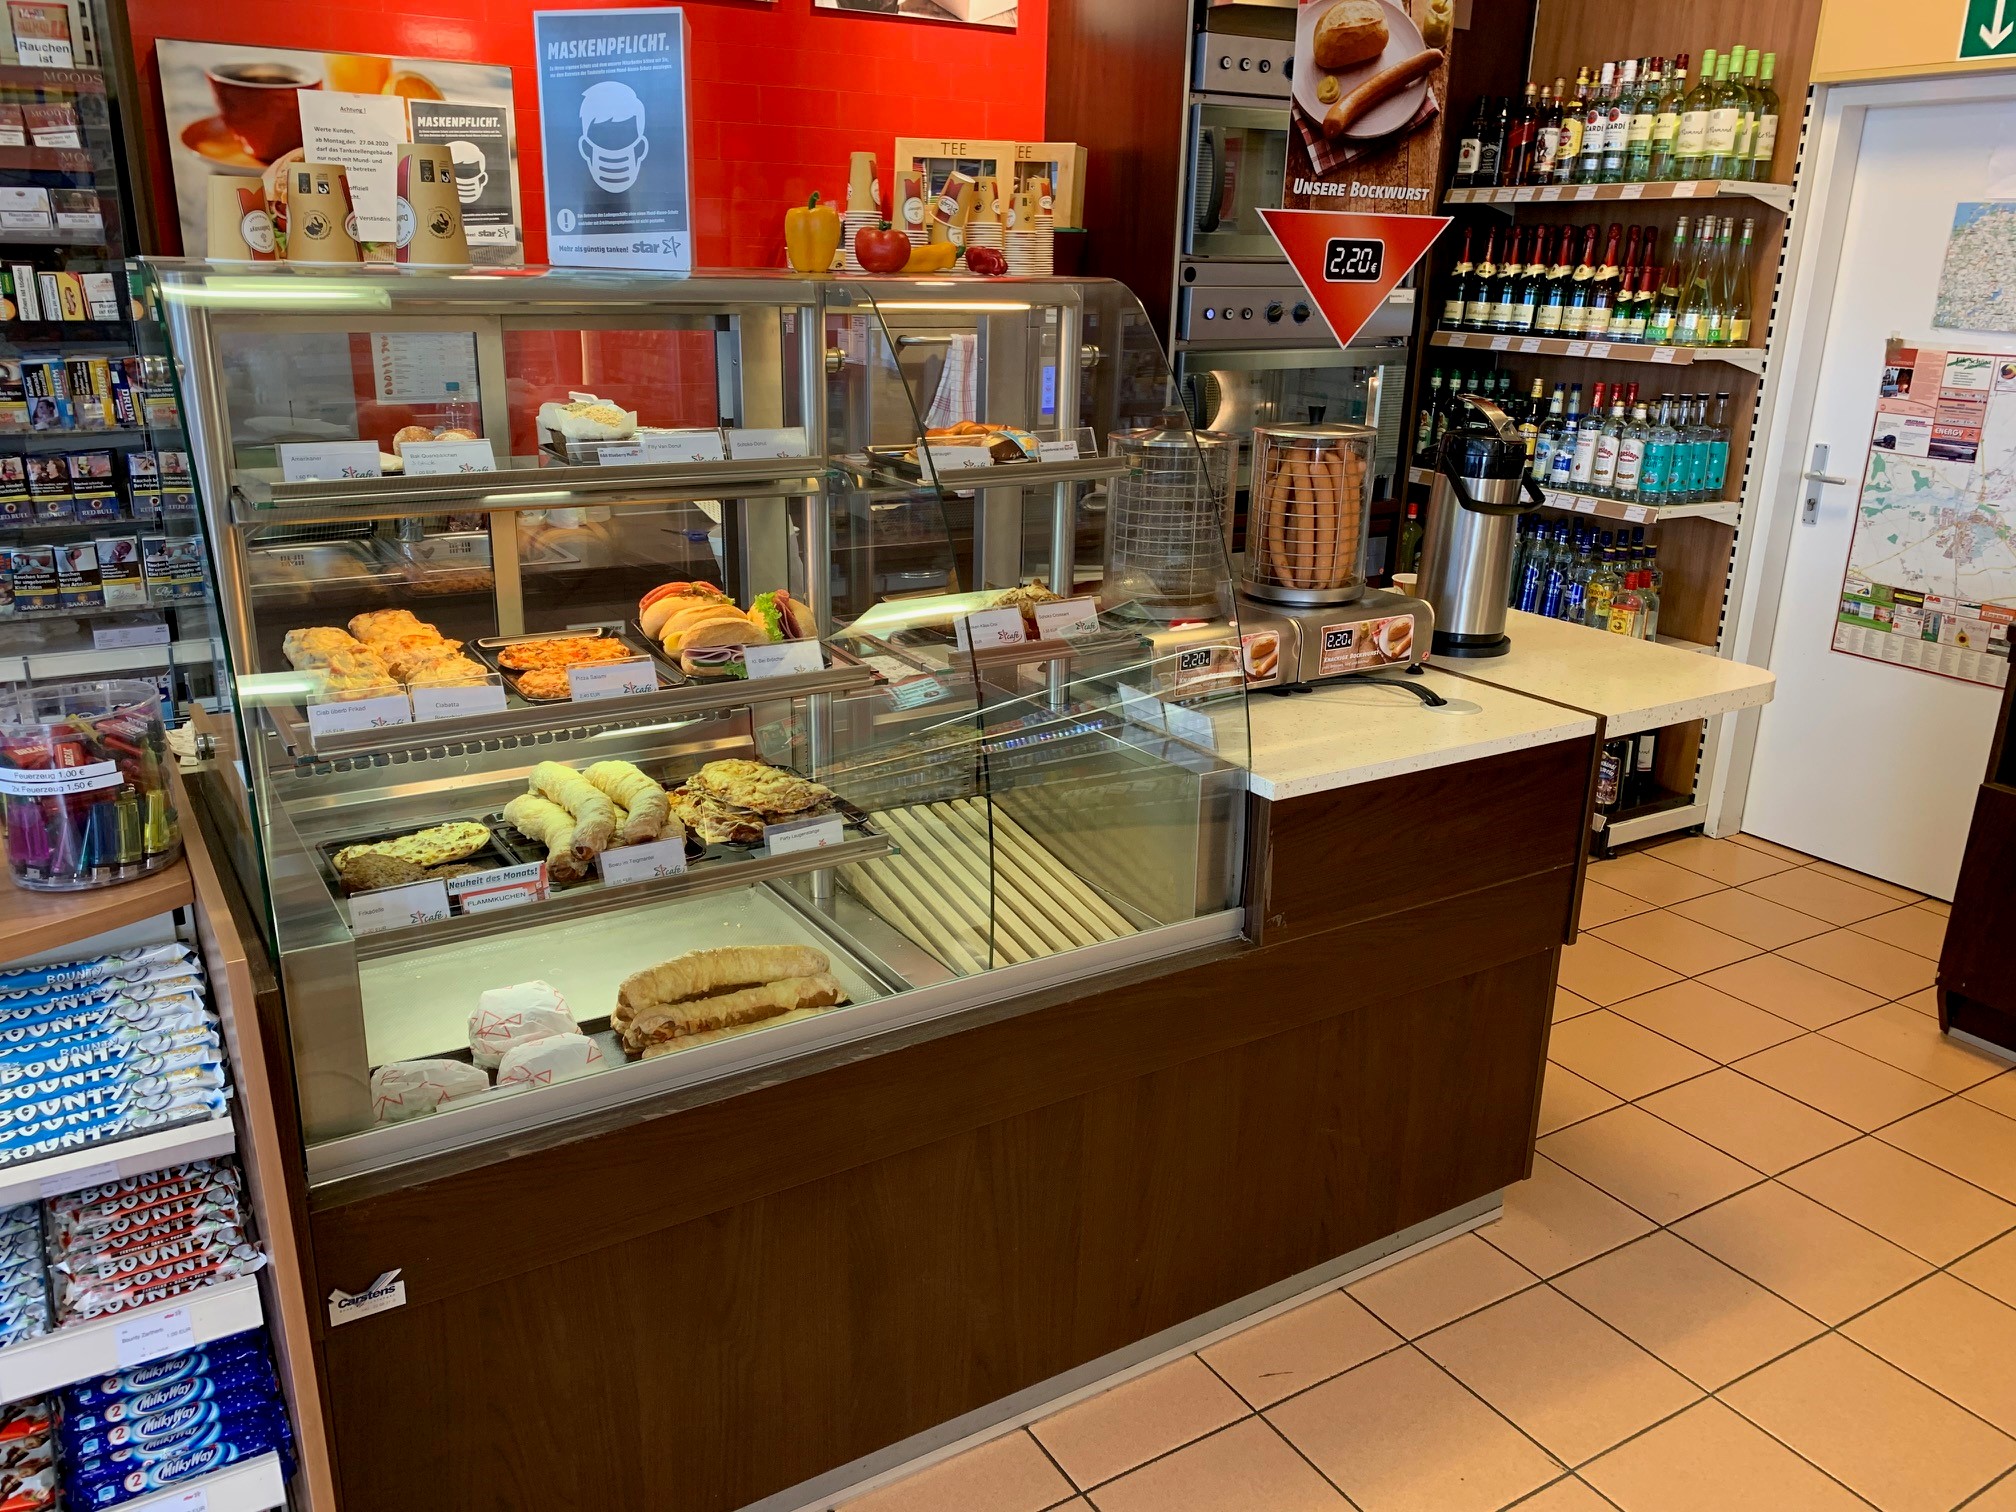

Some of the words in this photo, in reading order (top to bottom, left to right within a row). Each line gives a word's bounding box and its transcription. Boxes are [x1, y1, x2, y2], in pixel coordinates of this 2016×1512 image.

[19, 41, 70, 53] Rauchen
[548, 33, 669, 60] MASKENPFLICHT.
[39, 55, 53, 63] ist
[43, 71, 103, 84] MOODS
[340, 106, 363, 114] Achtung
[417, 116, 500, 128] MASKENPFLICHT.
[340, 147, 393, 156] Tankstellengebäude
[941, 142, 967, 155] TEE
[477, 229, 496, 238] star
[574, 245, 583, 253] als
[583, 245, 605, 255] günstig
[606, 246, 629, 254] tanken!
[631, 240, 660, 253] star
[120, 388, 136, 421] DRUM
[21, 603, 56, 611] SAMSON
[67, 600, 100, 608] SAMSON
[1006, 631, 1021, 642] café
[635, 683, 653, 694] café
[14, 771, 56, 780] Feuerzeug
[58, 769, 77, 779] 1,00
[21, 783, 64, 794] Feuerzeug
[66, 782, 86, 792] 1,50
[87, 780, 93, 788] €
[665, 865, 684, 876] café
[449, 876, 483, 890] Neuheit
[485, 873, 501, 883] des
[503, 867, 538, 881] Monats!
[467, 891, 527, 907] FLAMMKUCHEN
[424, 910, 443, 923] café
[46, 966, 103, 985] BOUNTY
[0, 1041, 134, 1085] BOUNTY
[101, 1174, 210, 1216] BOUNTY
[98, 1230, 214, 1280] BOUNTY
[113, 1250, 229, 1293] BOUNTY
[338, 1285, 396, 1309] Carstens
[109, 1379, 117, 1390] 2
[112, 1405, 122, 1417] 2
[116, 1427, 125, 1440] 2
[131, 1474, 142, 1487] 2
